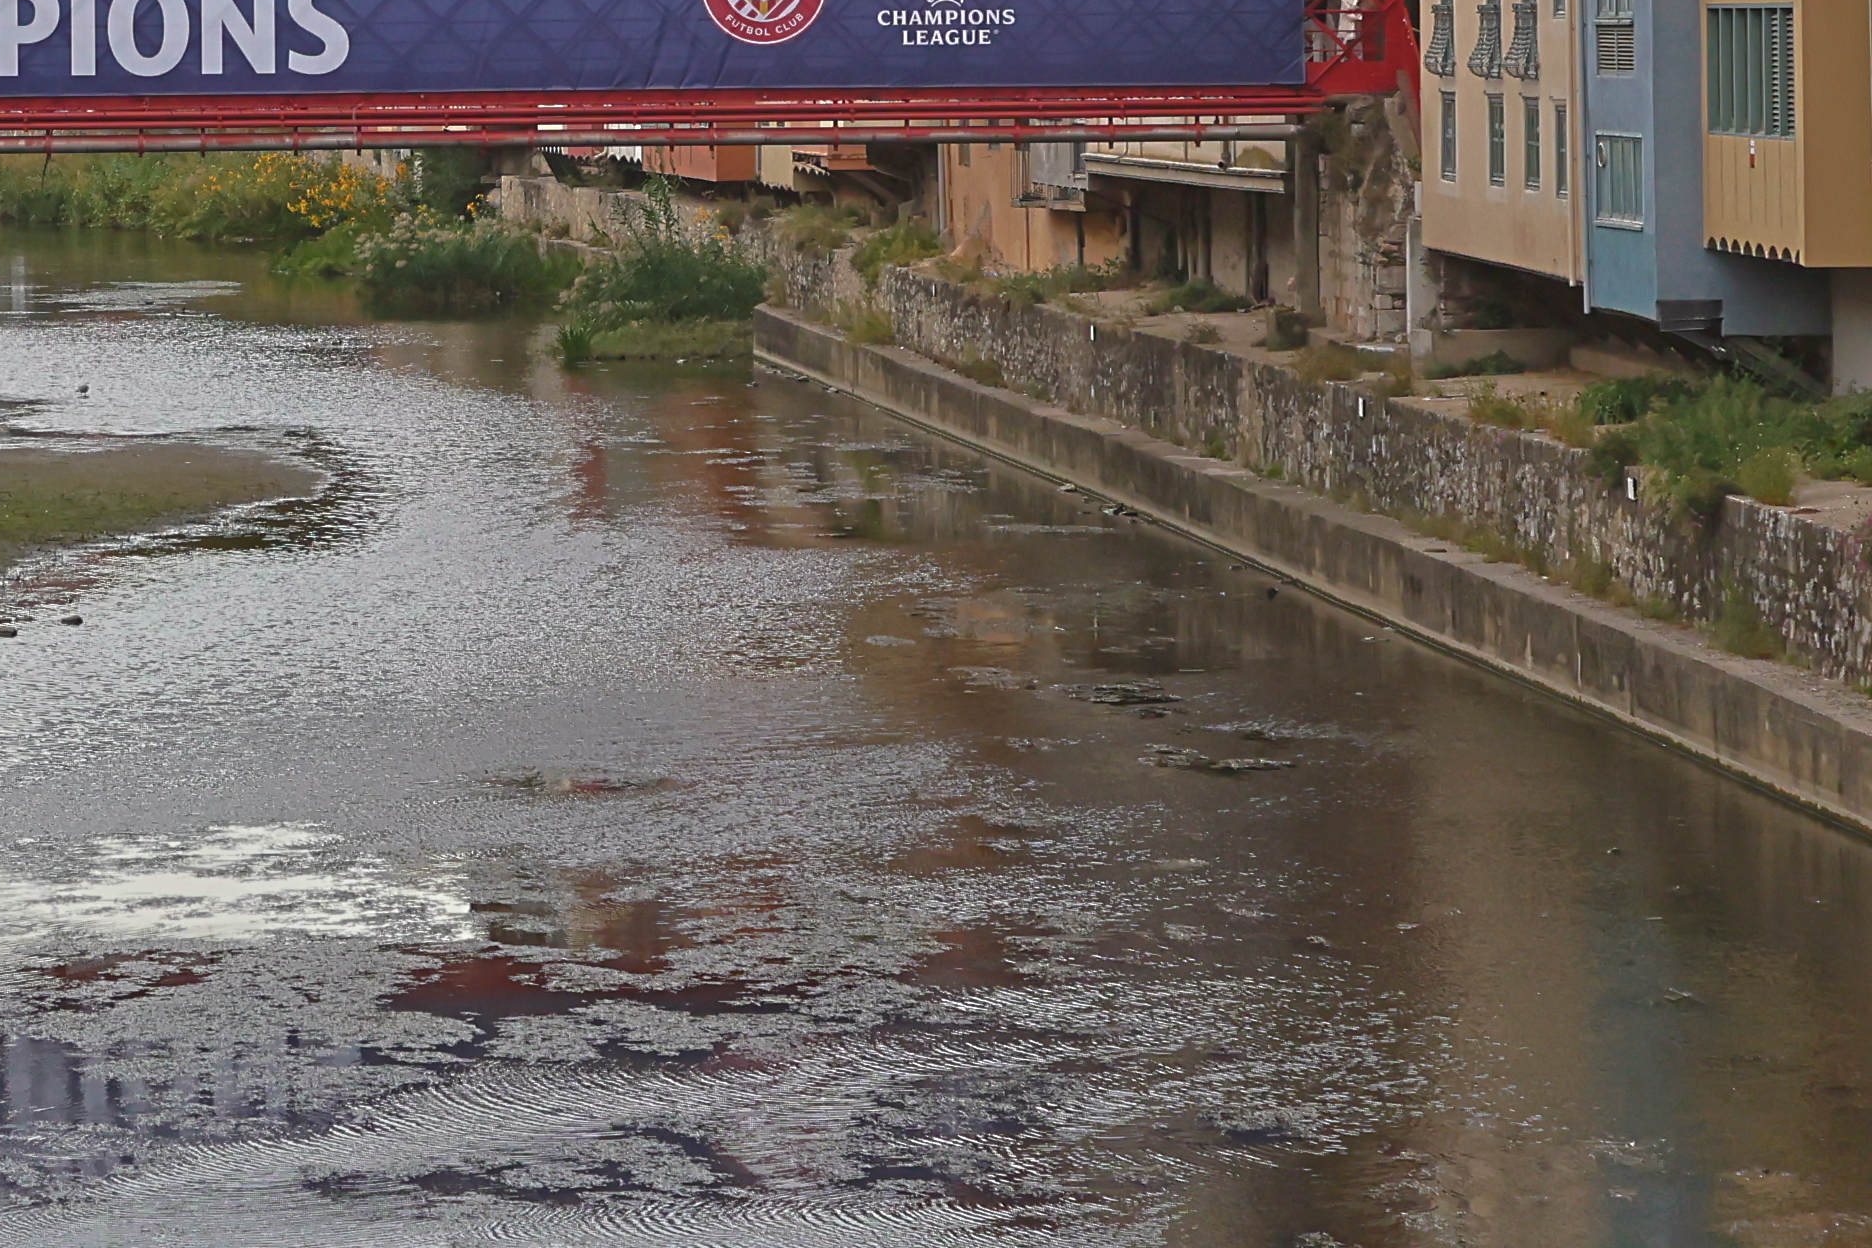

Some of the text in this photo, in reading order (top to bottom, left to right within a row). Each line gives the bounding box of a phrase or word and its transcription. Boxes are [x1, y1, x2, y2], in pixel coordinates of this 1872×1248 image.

[725, 13, 804, 36] FUTBOL CLUB
[877, 9, 1016, 26] CHAMPIONS
[902, 29, 991, 46] LEAGUE
